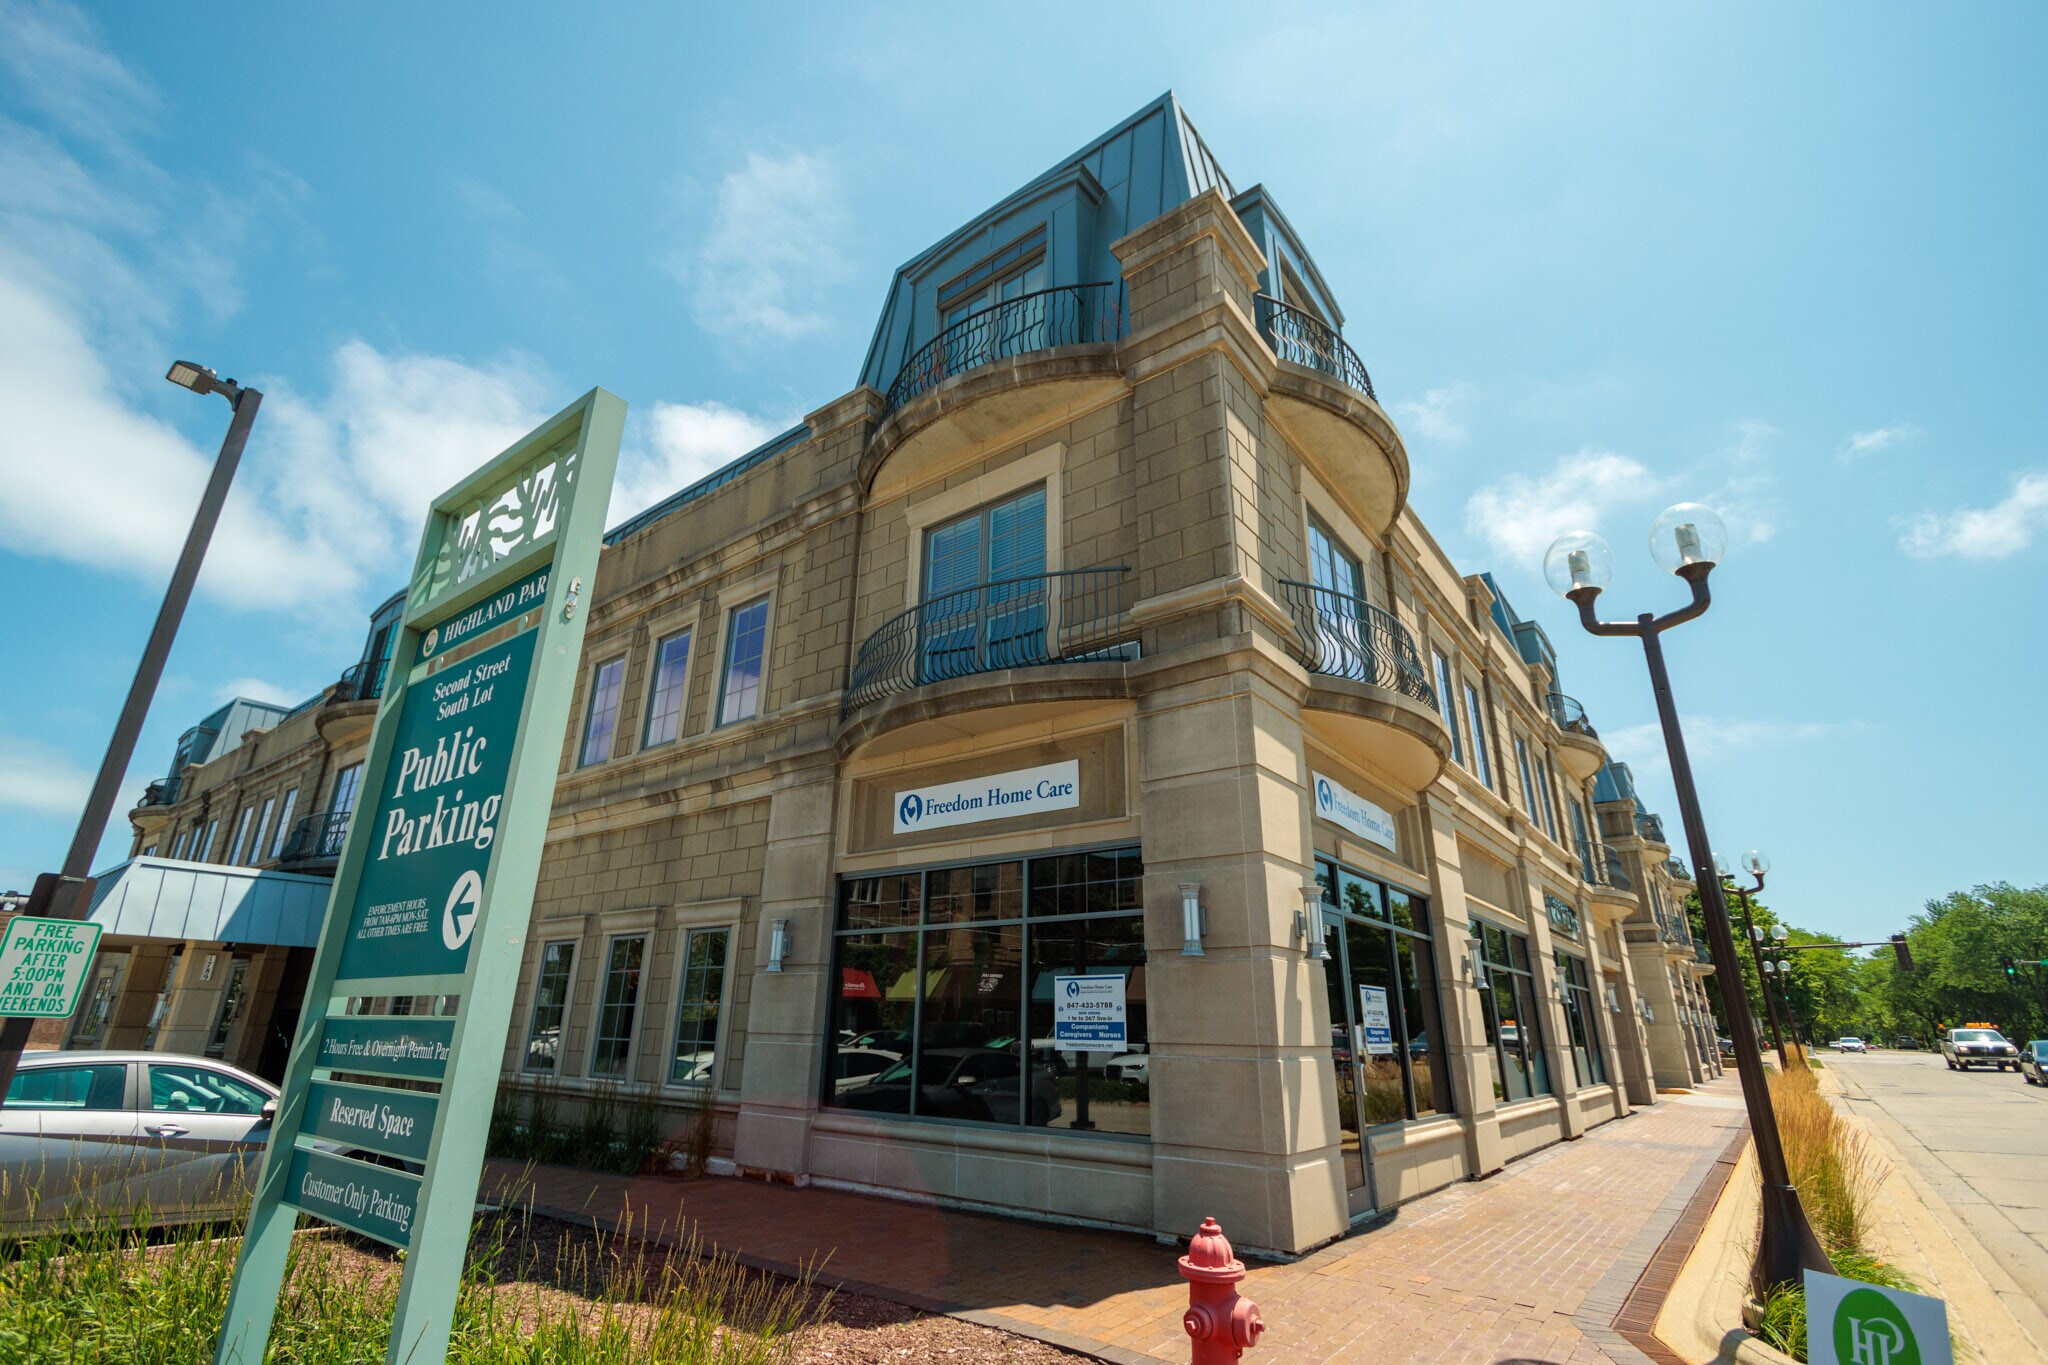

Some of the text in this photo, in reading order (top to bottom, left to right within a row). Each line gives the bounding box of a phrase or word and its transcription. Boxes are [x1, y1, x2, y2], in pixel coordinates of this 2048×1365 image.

[443, 573, 551, 643] HIGHLAND PAR
[433, 653, 511, 701] Second Street
[436, 683, 494, 721] South Lot
[392, 726, 487, 799] Public
[925, 780, 1073, 816] Freedom Home Care
[377, 789, 501, 861] Parking
[367, 897, 427, 916] ENFORCEMENT HOURS
[34, 923, 77, 939] FREE
[356, 929, 366, 939] ALL
[366, 926, 384, 938] OTHER
[384, 924, 401, 936] TIMES
[401, 922, 413, 934] ARE
[362, 916, 379, 927] FROM
[14, 937, 85, 954] PARKING
[21, 952, 68, 967] AFTER
[11, 966, 65, 982] 5:00PM
[2, 981, 64, 997] AND ON
[1059, 1031, 1121, 1039] Caregivers Nurses
[1071, 1023, 1109, 1031] Companions
[323, 1038, 450, 1062] 2 Hours Free & Overnight Permit Par
[330, 1097, 414, 1139] Reserved Space
[301, 1171, 411, 1232] Customer Only Parking
